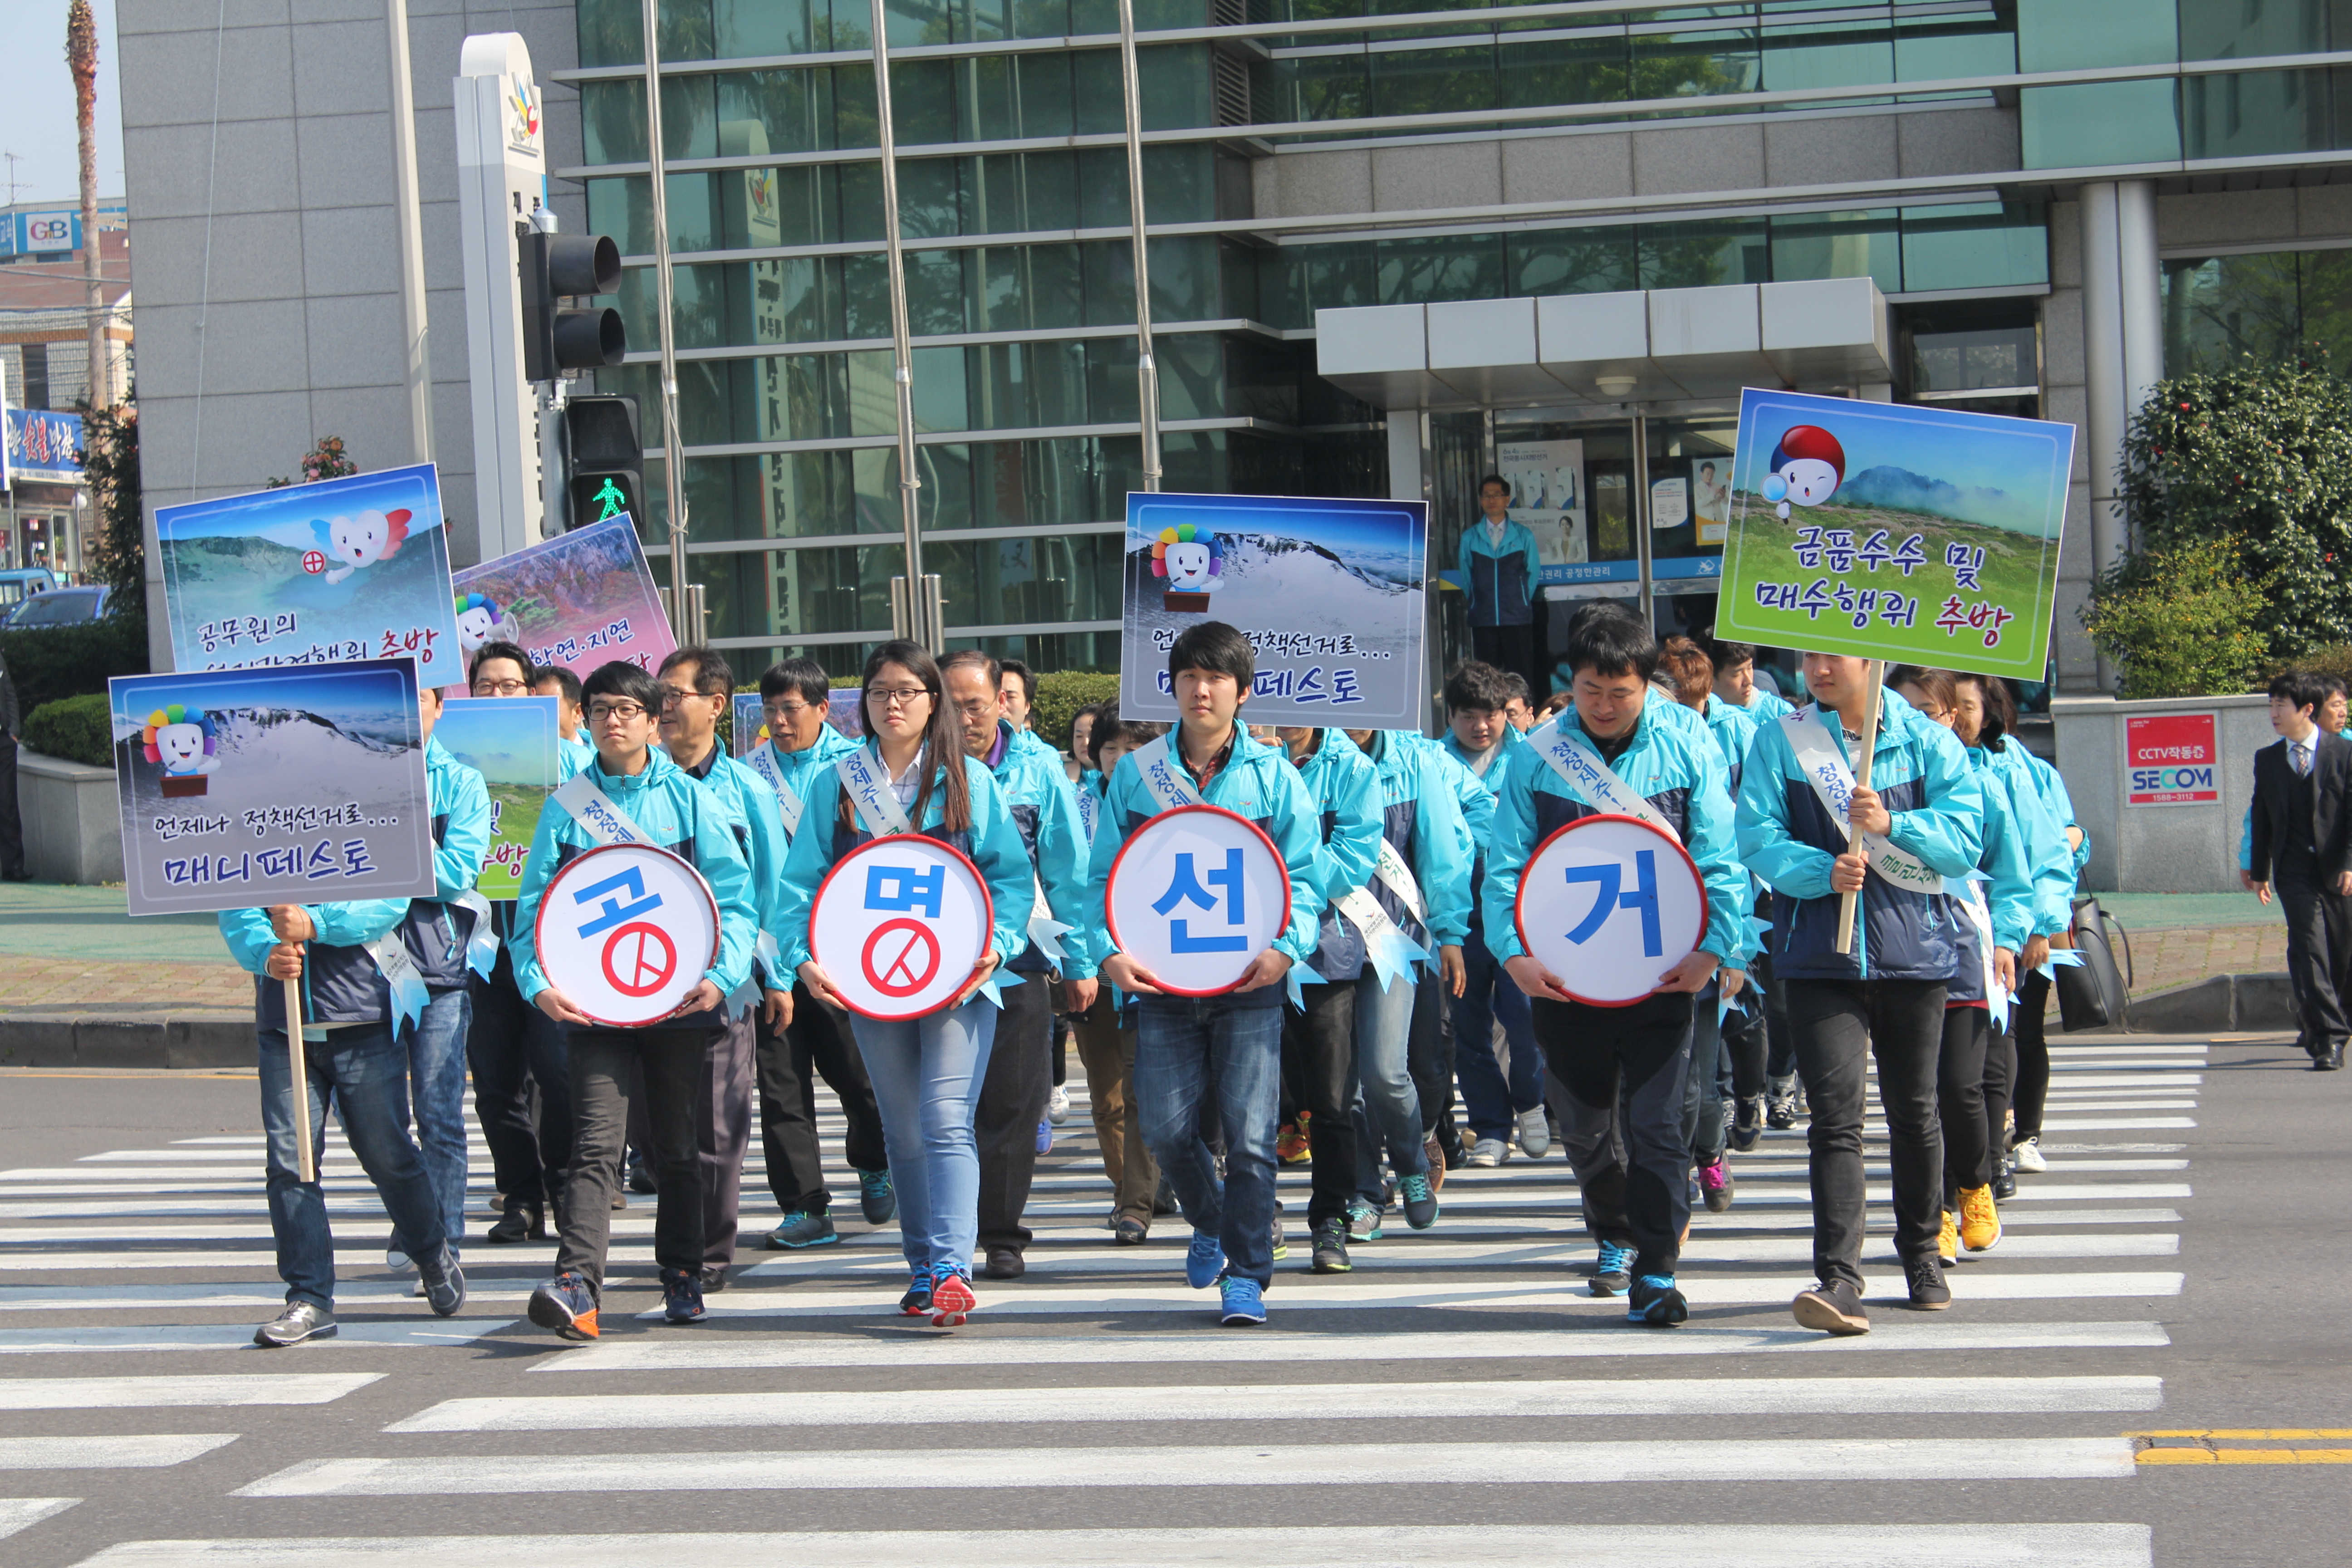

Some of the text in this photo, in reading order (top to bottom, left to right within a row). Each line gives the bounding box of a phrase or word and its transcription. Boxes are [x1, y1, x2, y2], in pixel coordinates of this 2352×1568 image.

[30, 221, 68, 240] GnB
[1566, 567, 1610, 578] 공정한관리
[1793, 527, 1985, 590] 금품수수 및
[200, 613, 296, 652] 공무원의
[1756, 578, 2013, 647] 매수행위 추방
[380, 629, 439, 662] 추방
[2138, 745, 2205, 760] CCTV작동중
[1550, 741, 1627, 811] 청정제주!
[2133, 768, 2212, 790] SECOM
[2153, 793, 2194, 801] 1588-3112
[155, 815, 229, 840] 언제나
[164, 839, 377, 883] 매니페스토
[1378, 848, 1411, 892] 선거!
[1151, 848, 1248, 954] 선
[1565, 850, 1663, 957] 거
[573, 865, 676, 997] 공
[862, 865, 946, 997] 명
